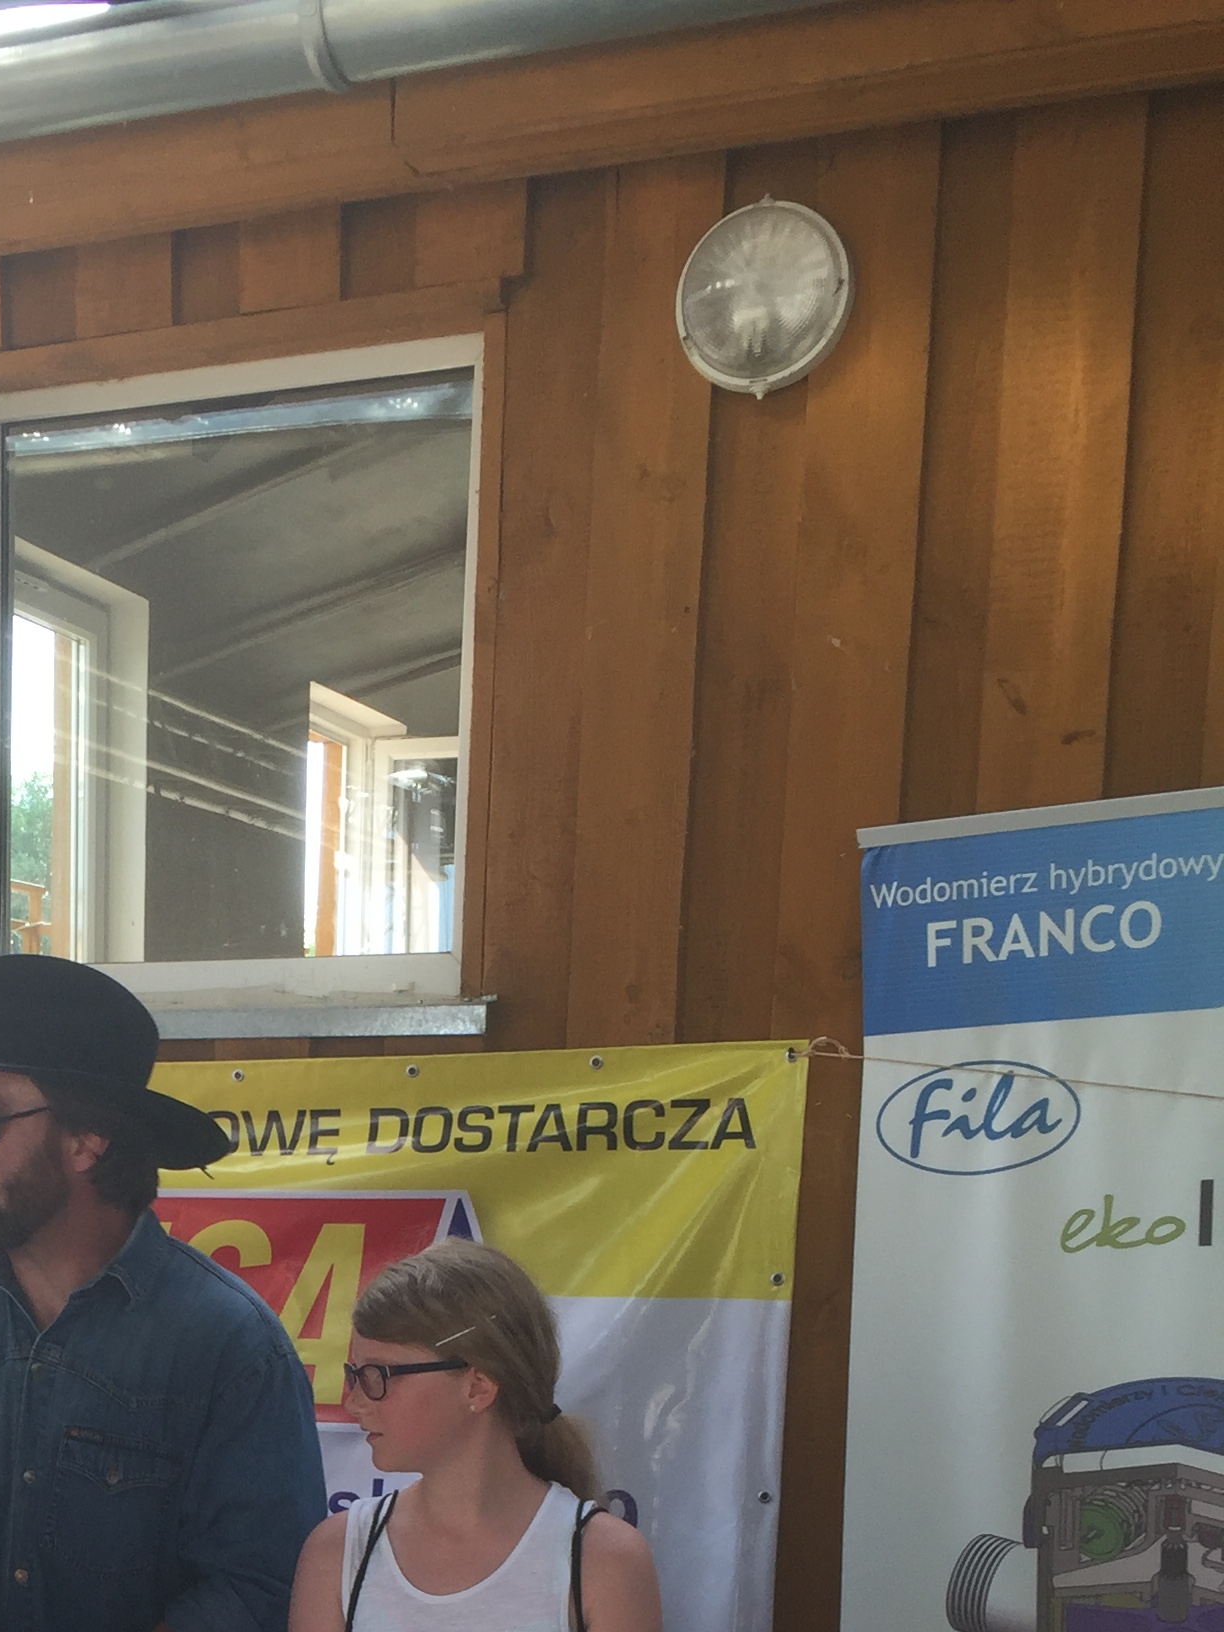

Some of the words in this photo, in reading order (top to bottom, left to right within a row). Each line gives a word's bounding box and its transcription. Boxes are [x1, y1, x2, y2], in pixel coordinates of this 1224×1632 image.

[870, 871, 1038, 909] Wodomierz
[1049, 852, 1224, 895] hybrydowy
[926, 900, 1162, 968] FRANCO
[366, 1097, 757, 1154] DOSTARCZA
